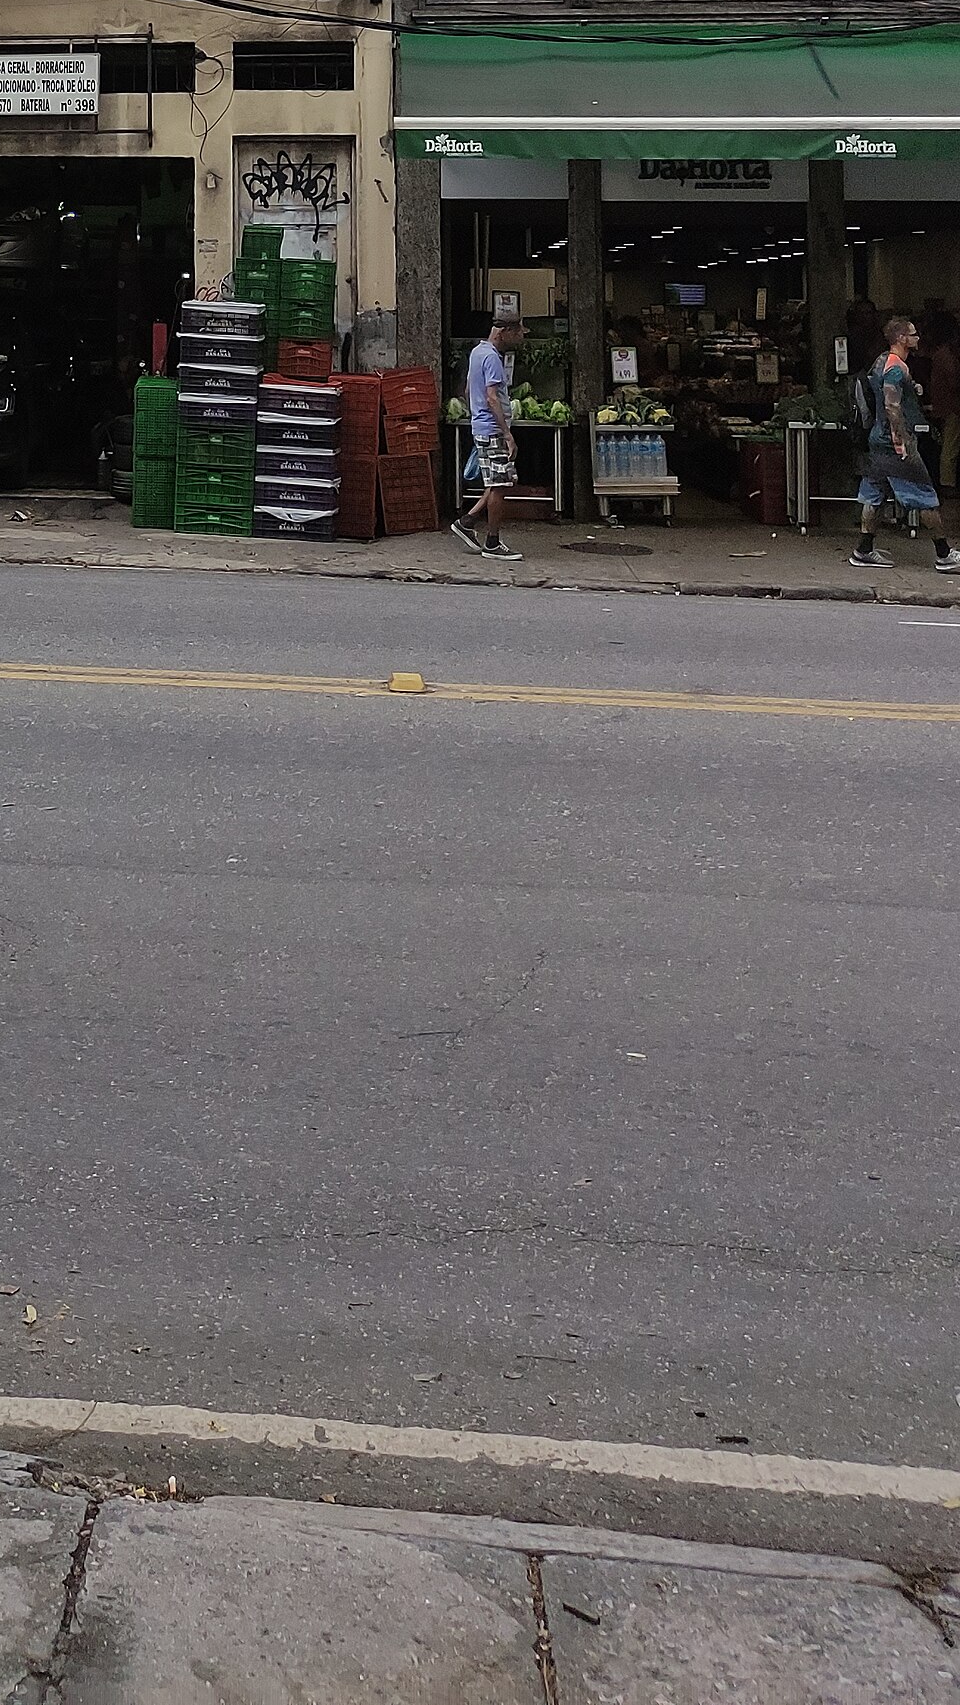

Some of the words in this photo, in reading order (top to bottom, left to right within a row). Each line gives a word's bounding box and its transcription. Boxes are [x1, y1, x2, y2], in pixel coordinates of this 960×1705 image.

[7, 61, 30, 74] GERAL
[35, 60, 85, 74] BORRACHEIRO
[42, 79, 64, 93] TROCA
[66, 79, 76, 92] DE
[77, 77, 96, 93] ÓLEO
[20, 99, 50, 112] BATERIA
[75, 99, 95, 112] 398
